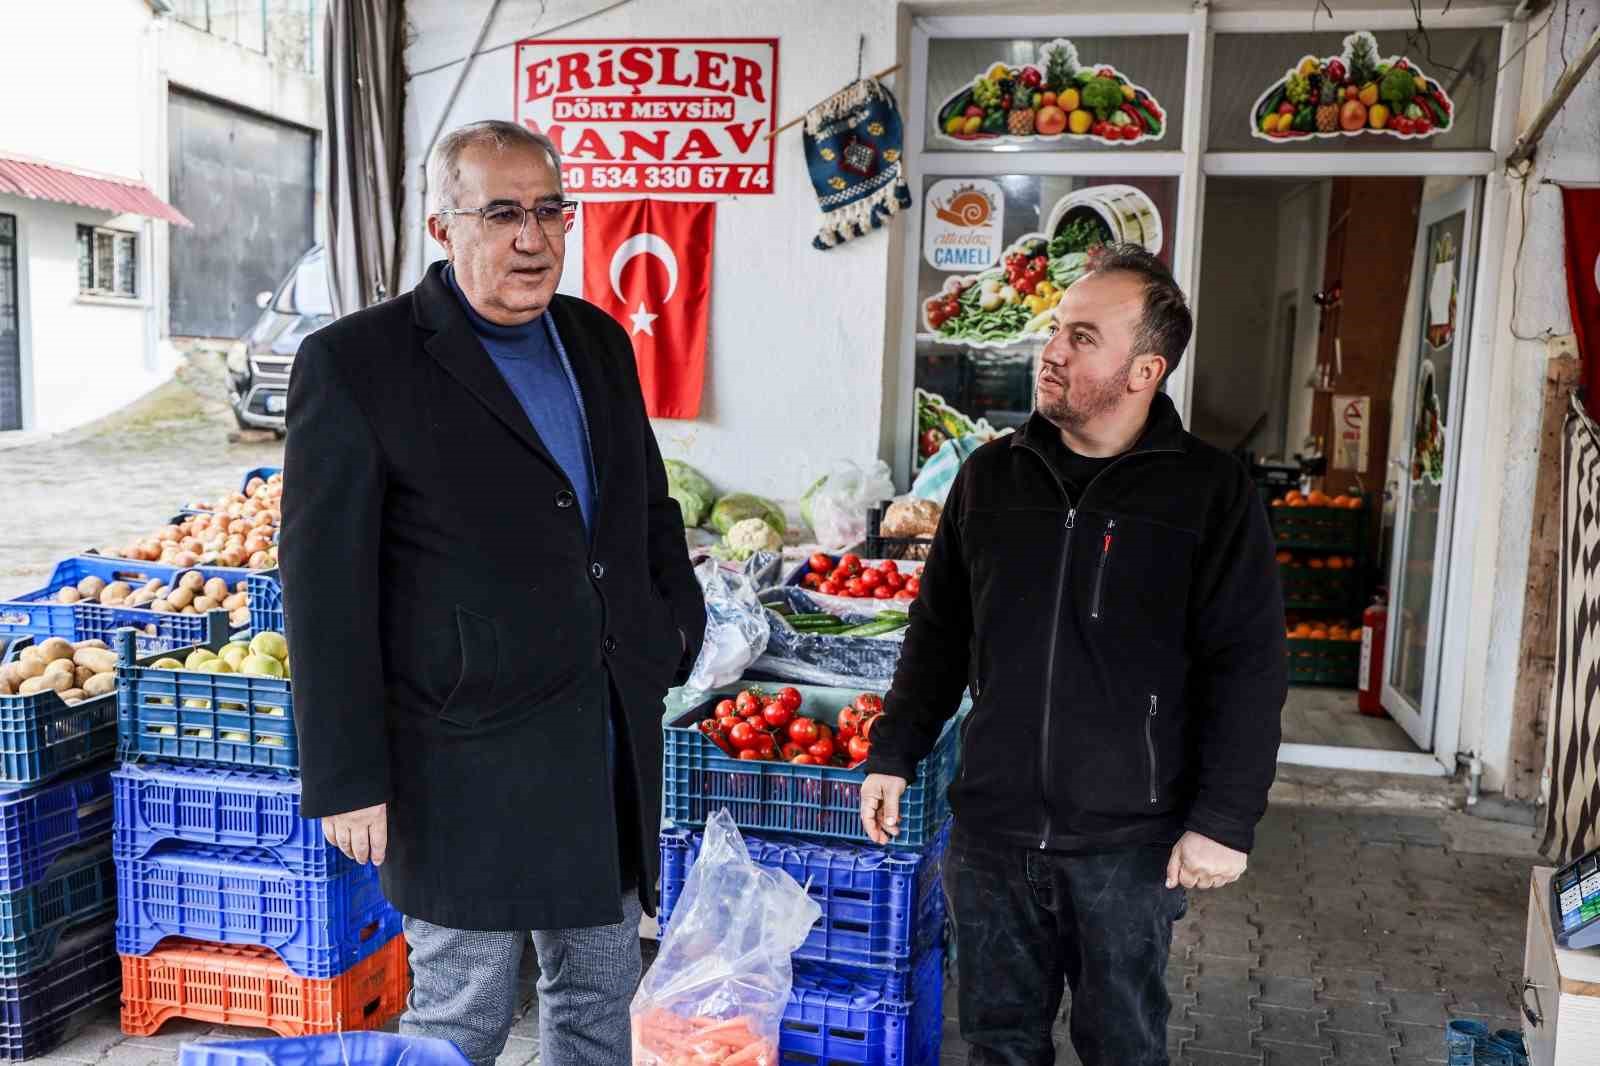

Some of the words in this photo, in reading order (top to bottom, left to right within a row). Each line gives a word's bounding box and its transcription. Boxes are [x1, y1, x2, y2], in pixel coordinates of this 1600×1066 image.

[555, 98, 625, 119] DÖRT
[631, 98, 733, 119] MEVSİM
[592, 167, 637, 188] 534
[645, 167, 692, 188] 330
[698, 167, 733, 188] 67
[738, 167, 768, 188] 74
